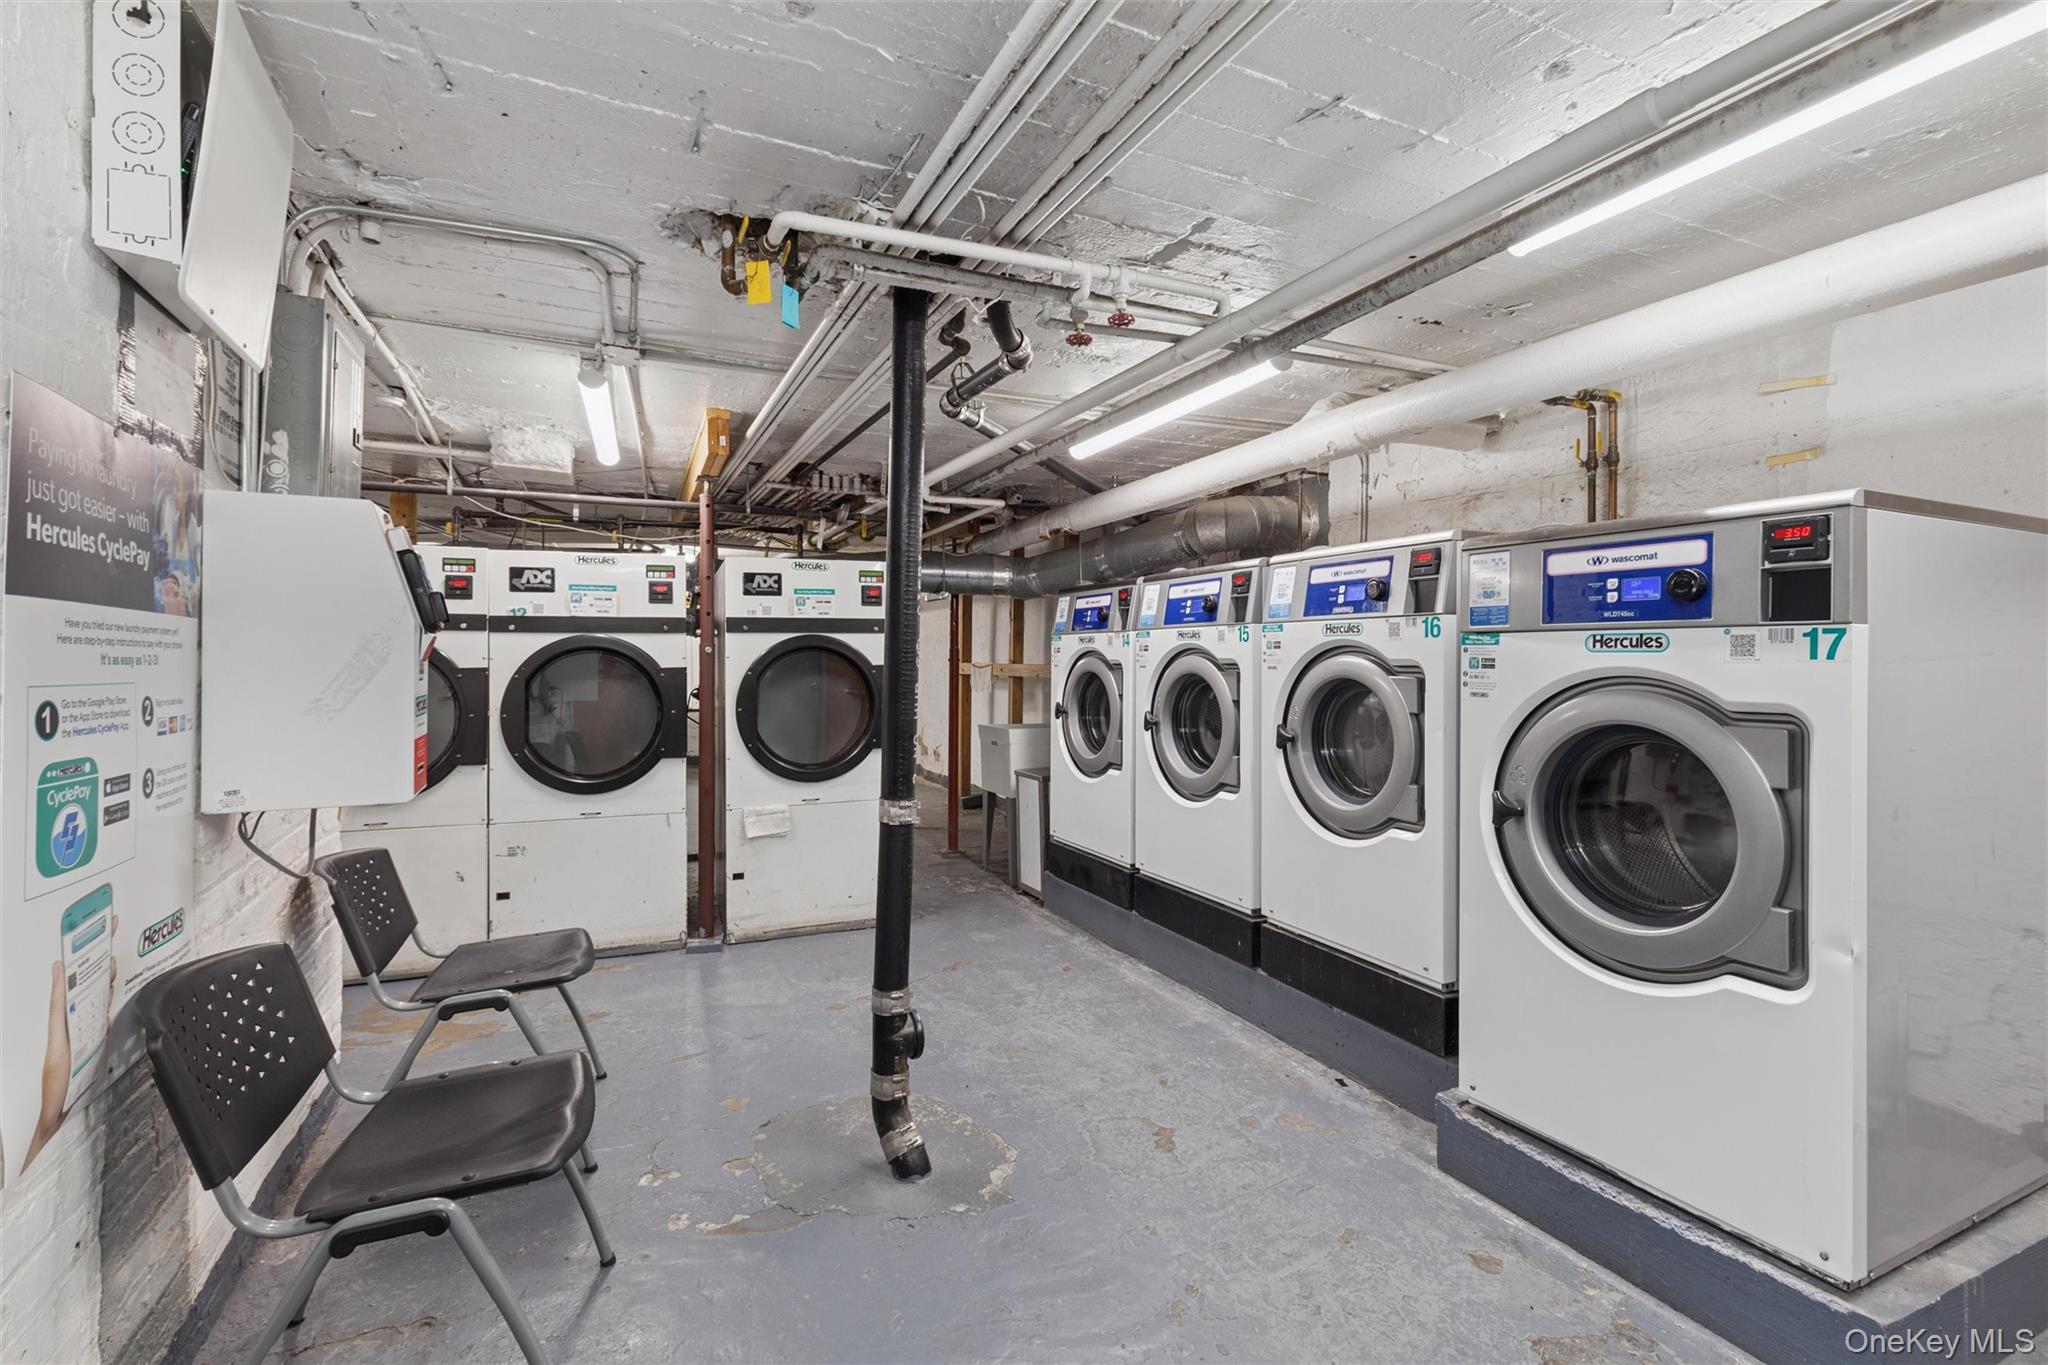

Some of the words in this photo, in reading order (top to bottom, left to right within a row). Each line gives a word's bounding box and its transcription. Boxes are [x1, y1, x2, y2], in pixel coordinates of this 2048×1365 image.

[28, 427, 76, 476] Paying
[78, 450, 95, 476] for
[96, 459, 137, 500] laundry
[25, 470, 55, 503] just
[58, 487, 81, 513] got
[84, 497, 116, 523] easier
[126, 510, 150, 534] with
[27, 512, 96, 554] Hercules
[97, 532, 150, 571] CyclePay
[577, 555, 616, 565] Hercules
[1611, 551, 1658, 564] wascomat
[794, 562, 827, 571] Hercules
[521, 569, 552, 585] ADC
[752, 574, 779, 588] ADC
[1177, 630, 1201, 639] Hercules
[1238, 626, 1249, 643] 15
[1325, 624, 1361, 634] Hercules
[1421, 616, 1441, 638] 16
[1122, 633, 1130, 648] 14
[1592, 634, 1664, 649] Hercules
[1802, 627, 1848, 661] 17
[120, 656, 135, 668] easy
[61, 699, 71, 709] Go
[71, 699, 77, 709] to
[78, 698, 87, 708] the
[87, 697, 105, 708] Google
[42, 706, 50, 733] 1
[144, 702, 152, 721] 2
[72, 726, 97, 737] Hercules
[97, 722, 119, 735] CyclePay
[145, 771, 152, 794] 3
[47, 785, 91, 808] CyclePay
[142, 912, 183, 951] Hercules
